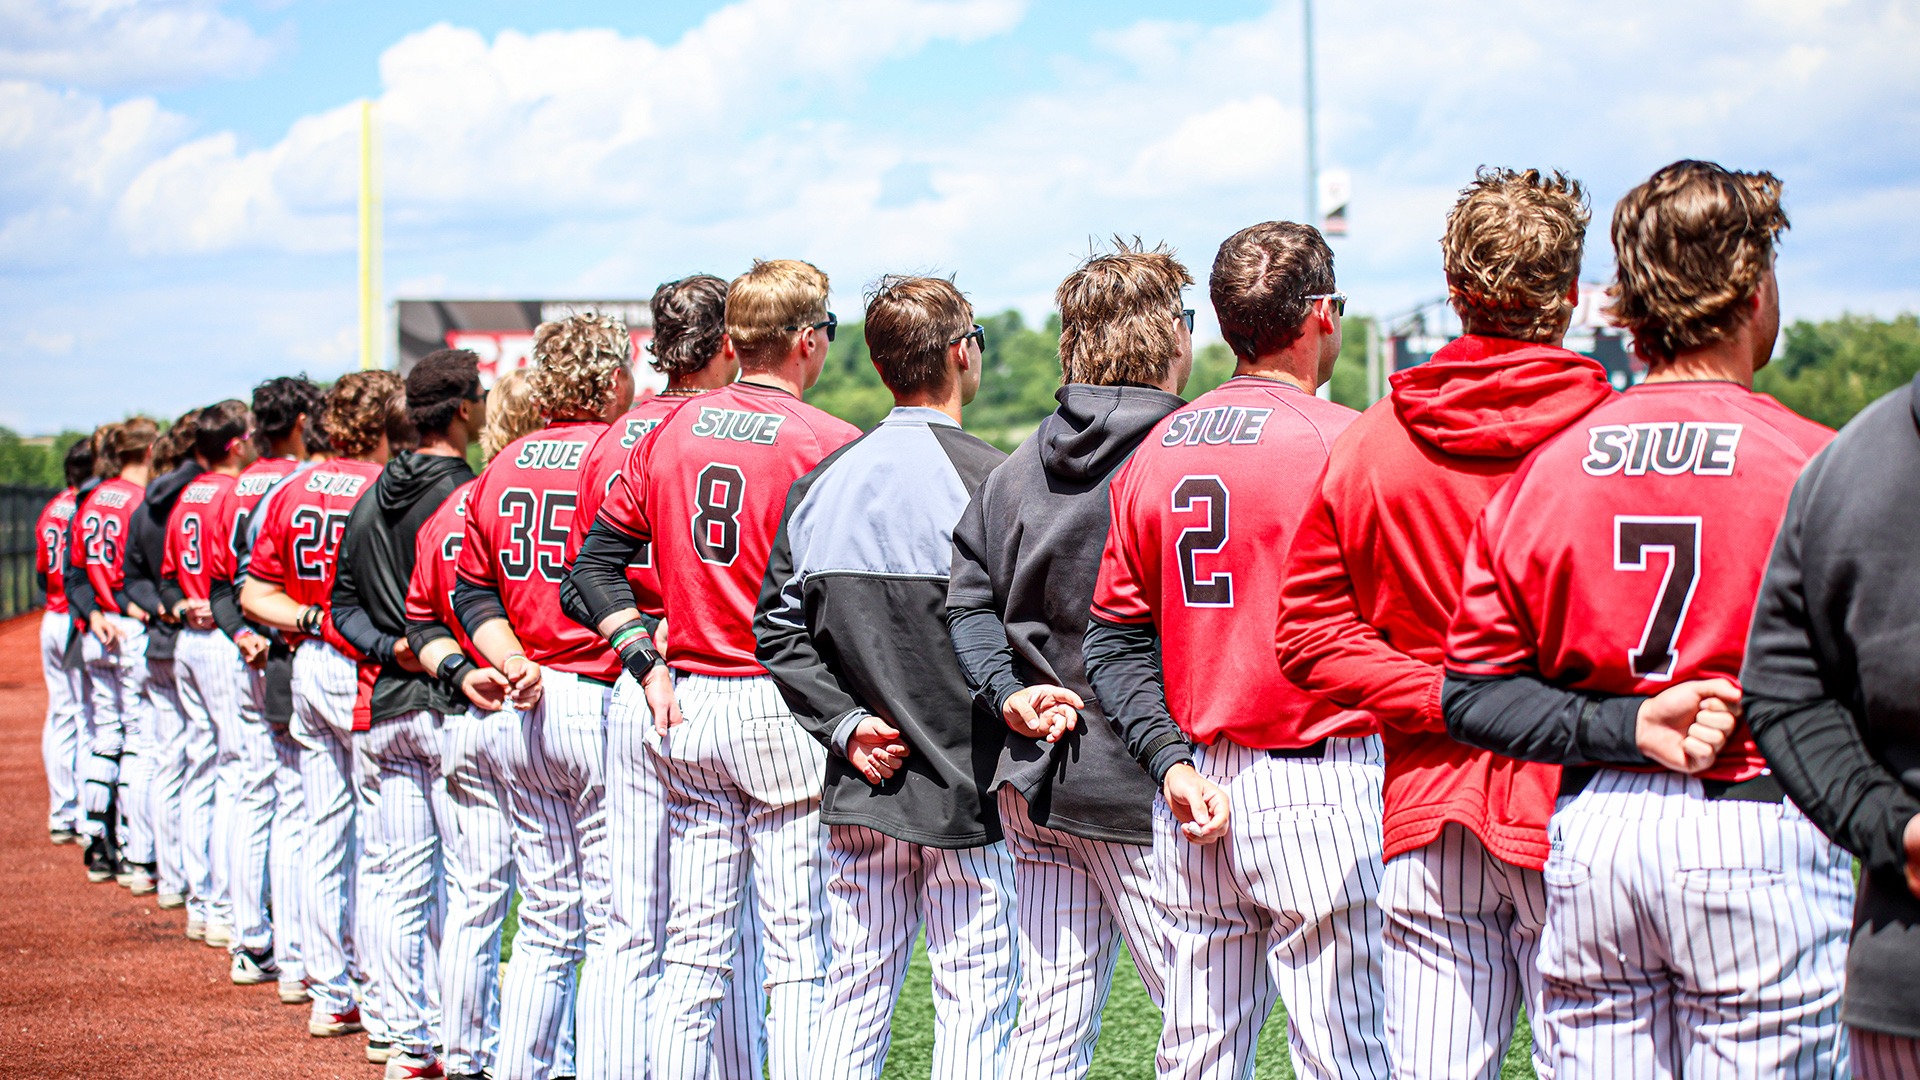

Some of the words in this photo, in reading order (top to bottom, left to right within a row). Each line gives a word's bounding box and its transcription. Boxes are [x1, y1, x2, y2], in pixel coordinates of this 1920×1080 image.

[692, 406, 786, 445] SIUE
[1161, 406, 1274, 447] SIUE
[1582, 422, 1743, 476] SIUE
[516, 440, 588, 470] SIUE
[94, 486, 131, 509] SIUE
[181, 482, 220, 504] SIUE
[305, 471, 366, 497] SIUE
[83, 510, 121, 568] 26
[499, 488, 577, 582] 35
[691, 461, 746, 567] 8
[44, 522, 68, 575] 3
[182, 512, 203, 575] 3
[1171, 474, 1234, 608] 2
[1614, 514, 1702, 681] 7
